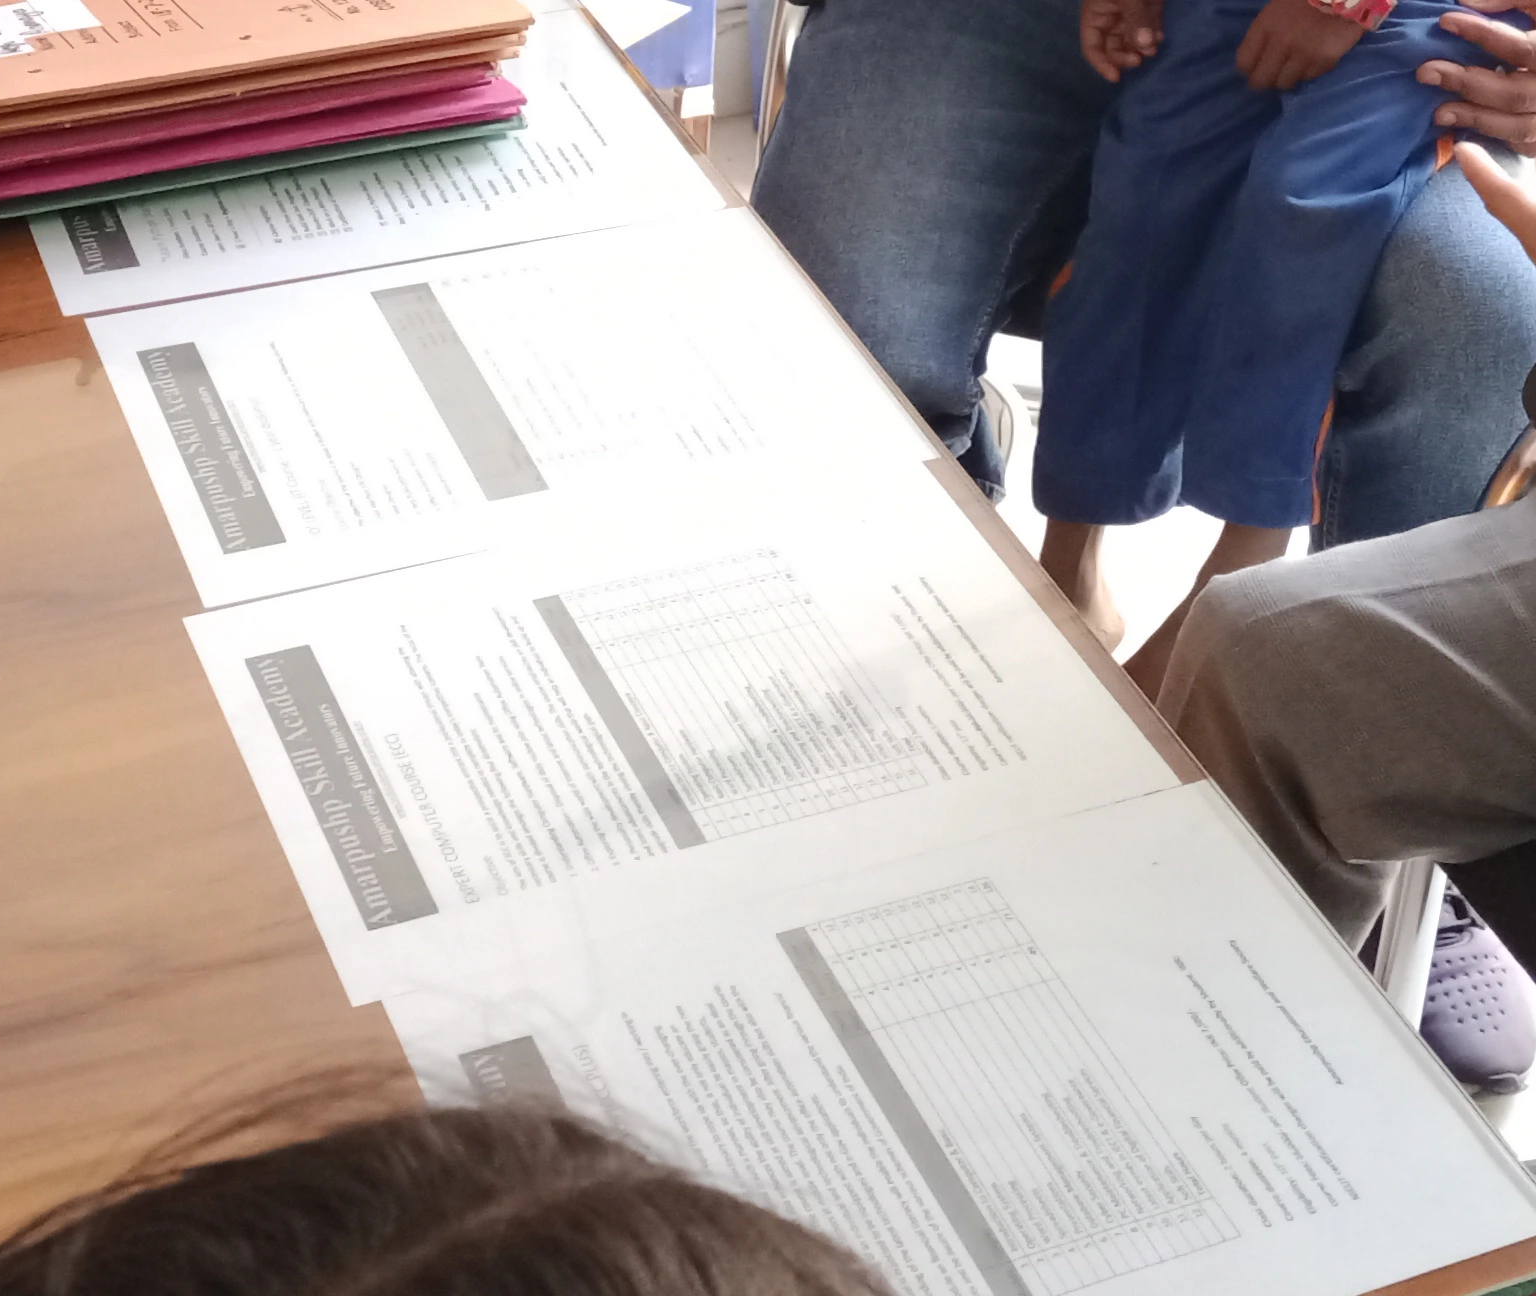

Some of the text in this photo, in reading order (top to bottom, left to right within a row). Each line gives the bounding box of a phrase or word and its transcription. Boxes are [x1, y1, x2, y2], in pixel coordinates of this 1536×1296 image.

[167, 417, 207, 456] Skill
[186, 454, 257, 553] Amarpushp
[247, 653, 319, 745] Academy
[313, 702, 353, 755] Innovators
[288, 745, 337, 797] Skill
[338, 754, 368, 788] Future
[396, 759, 430, 802] COURSE
[353, 787, 403, 854] Empowering
[417, 801, 460, 863] COMPUTER
[311, 794, 407, 929] Amarpushp
[447, 861, 482, 905] EXPERT
